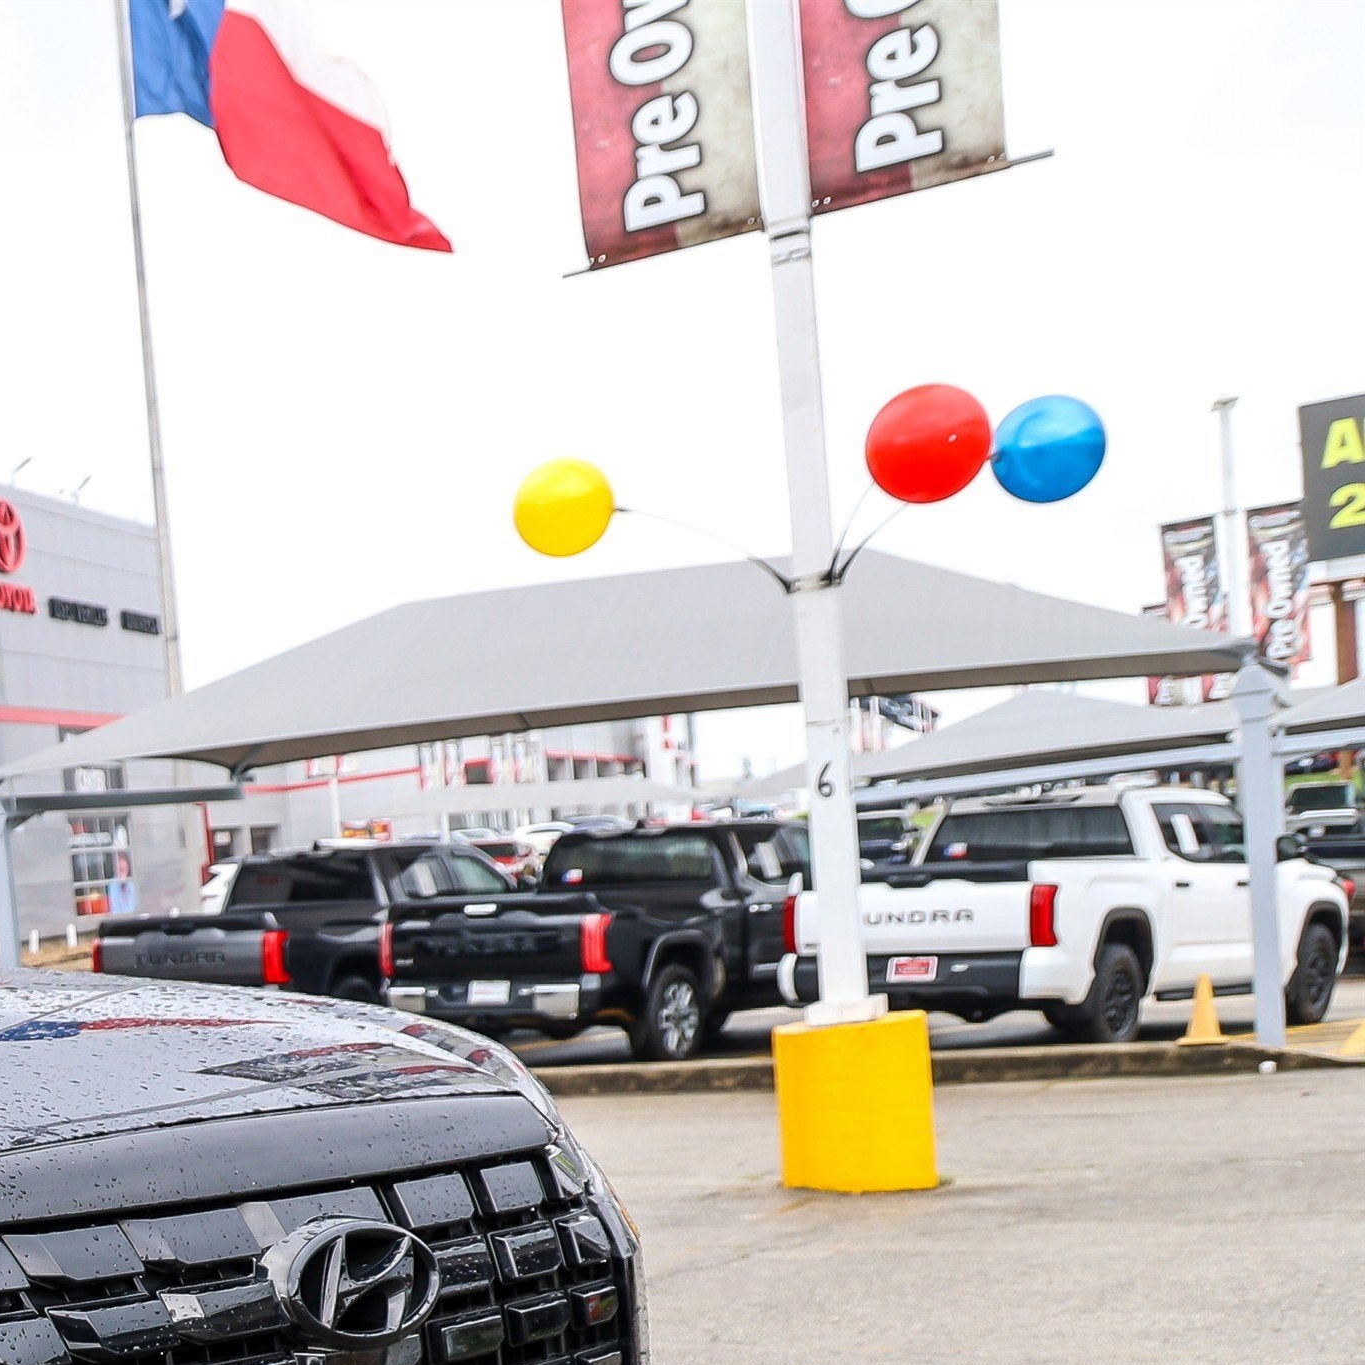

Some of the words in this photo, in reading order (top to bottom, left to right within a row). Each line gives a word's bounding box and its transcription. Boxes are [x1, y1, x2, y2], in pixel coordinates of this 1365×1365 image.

[855, 23, 944, 173] Pre
[623, 91, 706, 233] Pre
[1320, 417, 1365, 470] A
[817, 760, 834, 798] 6
[864, 908, 975, 926] UNDRA
